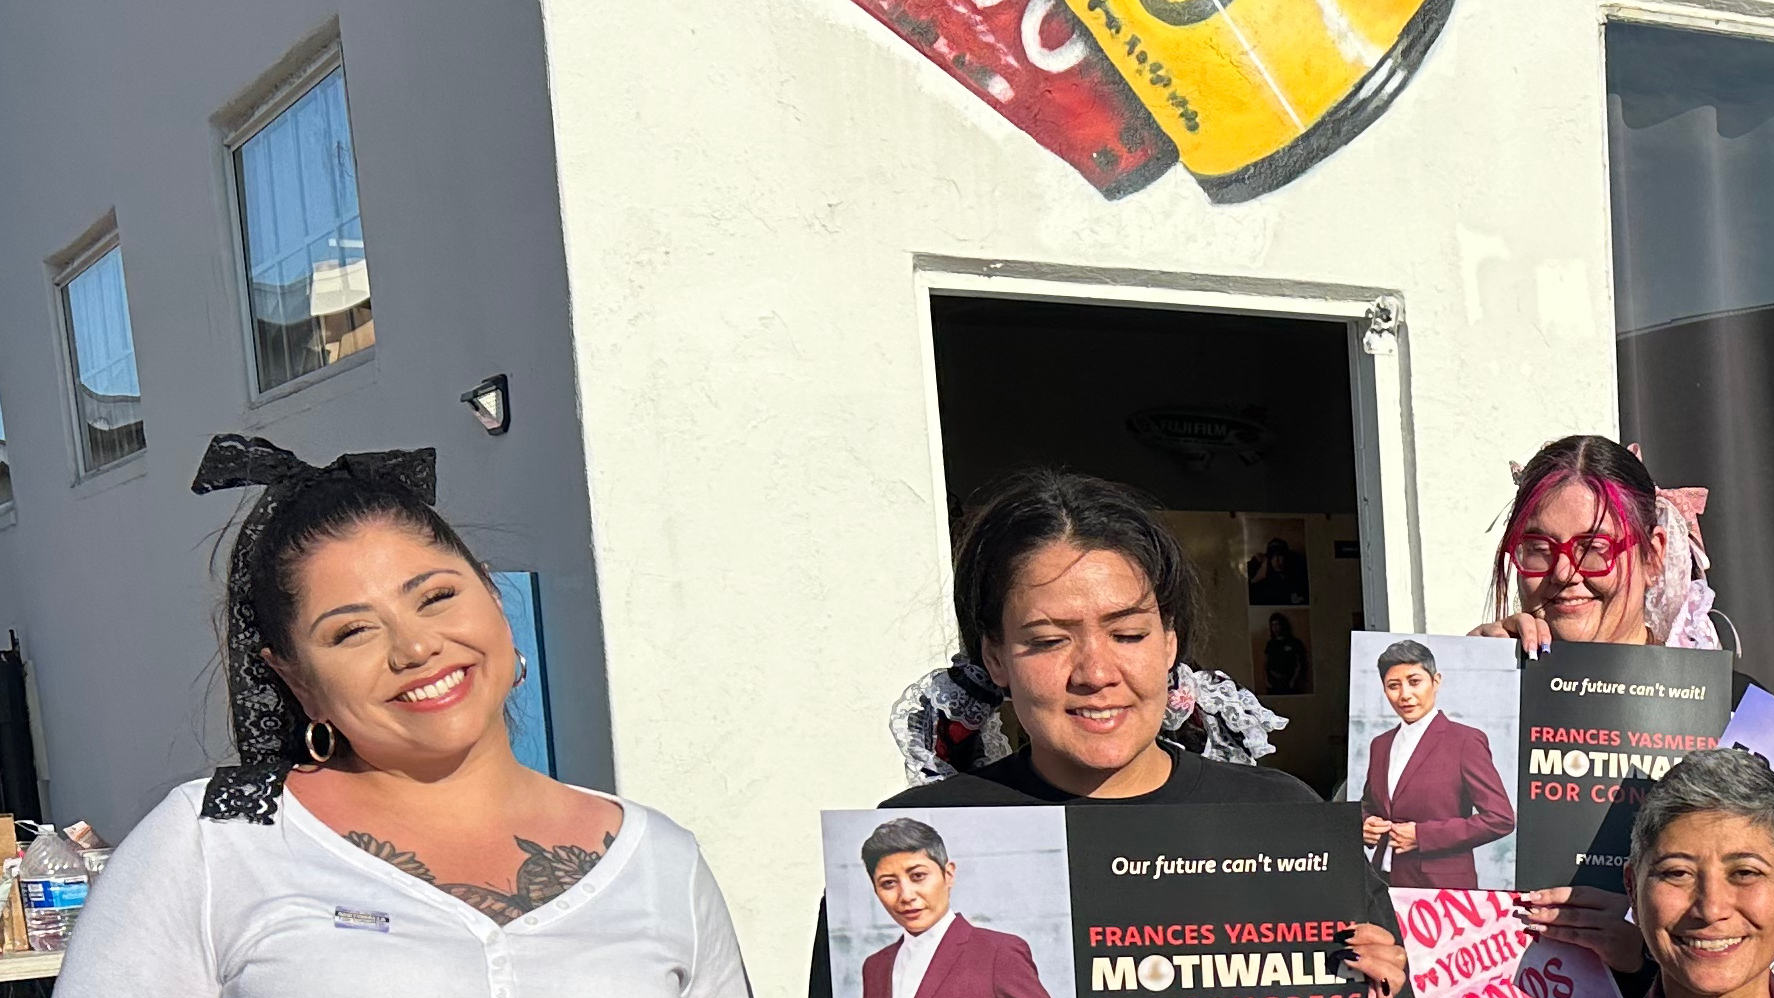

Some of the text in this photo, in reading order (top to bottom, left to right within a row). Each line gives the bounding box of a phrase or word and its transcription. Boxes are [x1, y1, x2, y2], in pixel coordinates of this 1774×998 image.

[1550, 677, 1705, 701] Our future can't wait!
[1530, 727, 1621, 746] FRANCES
[1529, 748, 1683, 781] MOTIWA
[1530, 781, 1580, 802] FOR
[1111, 852, 1329, 880] Our future can't wait!
[1089, 924, 1215, 947] FRANCES
[1435, 929, 1518, 987] YOUR
